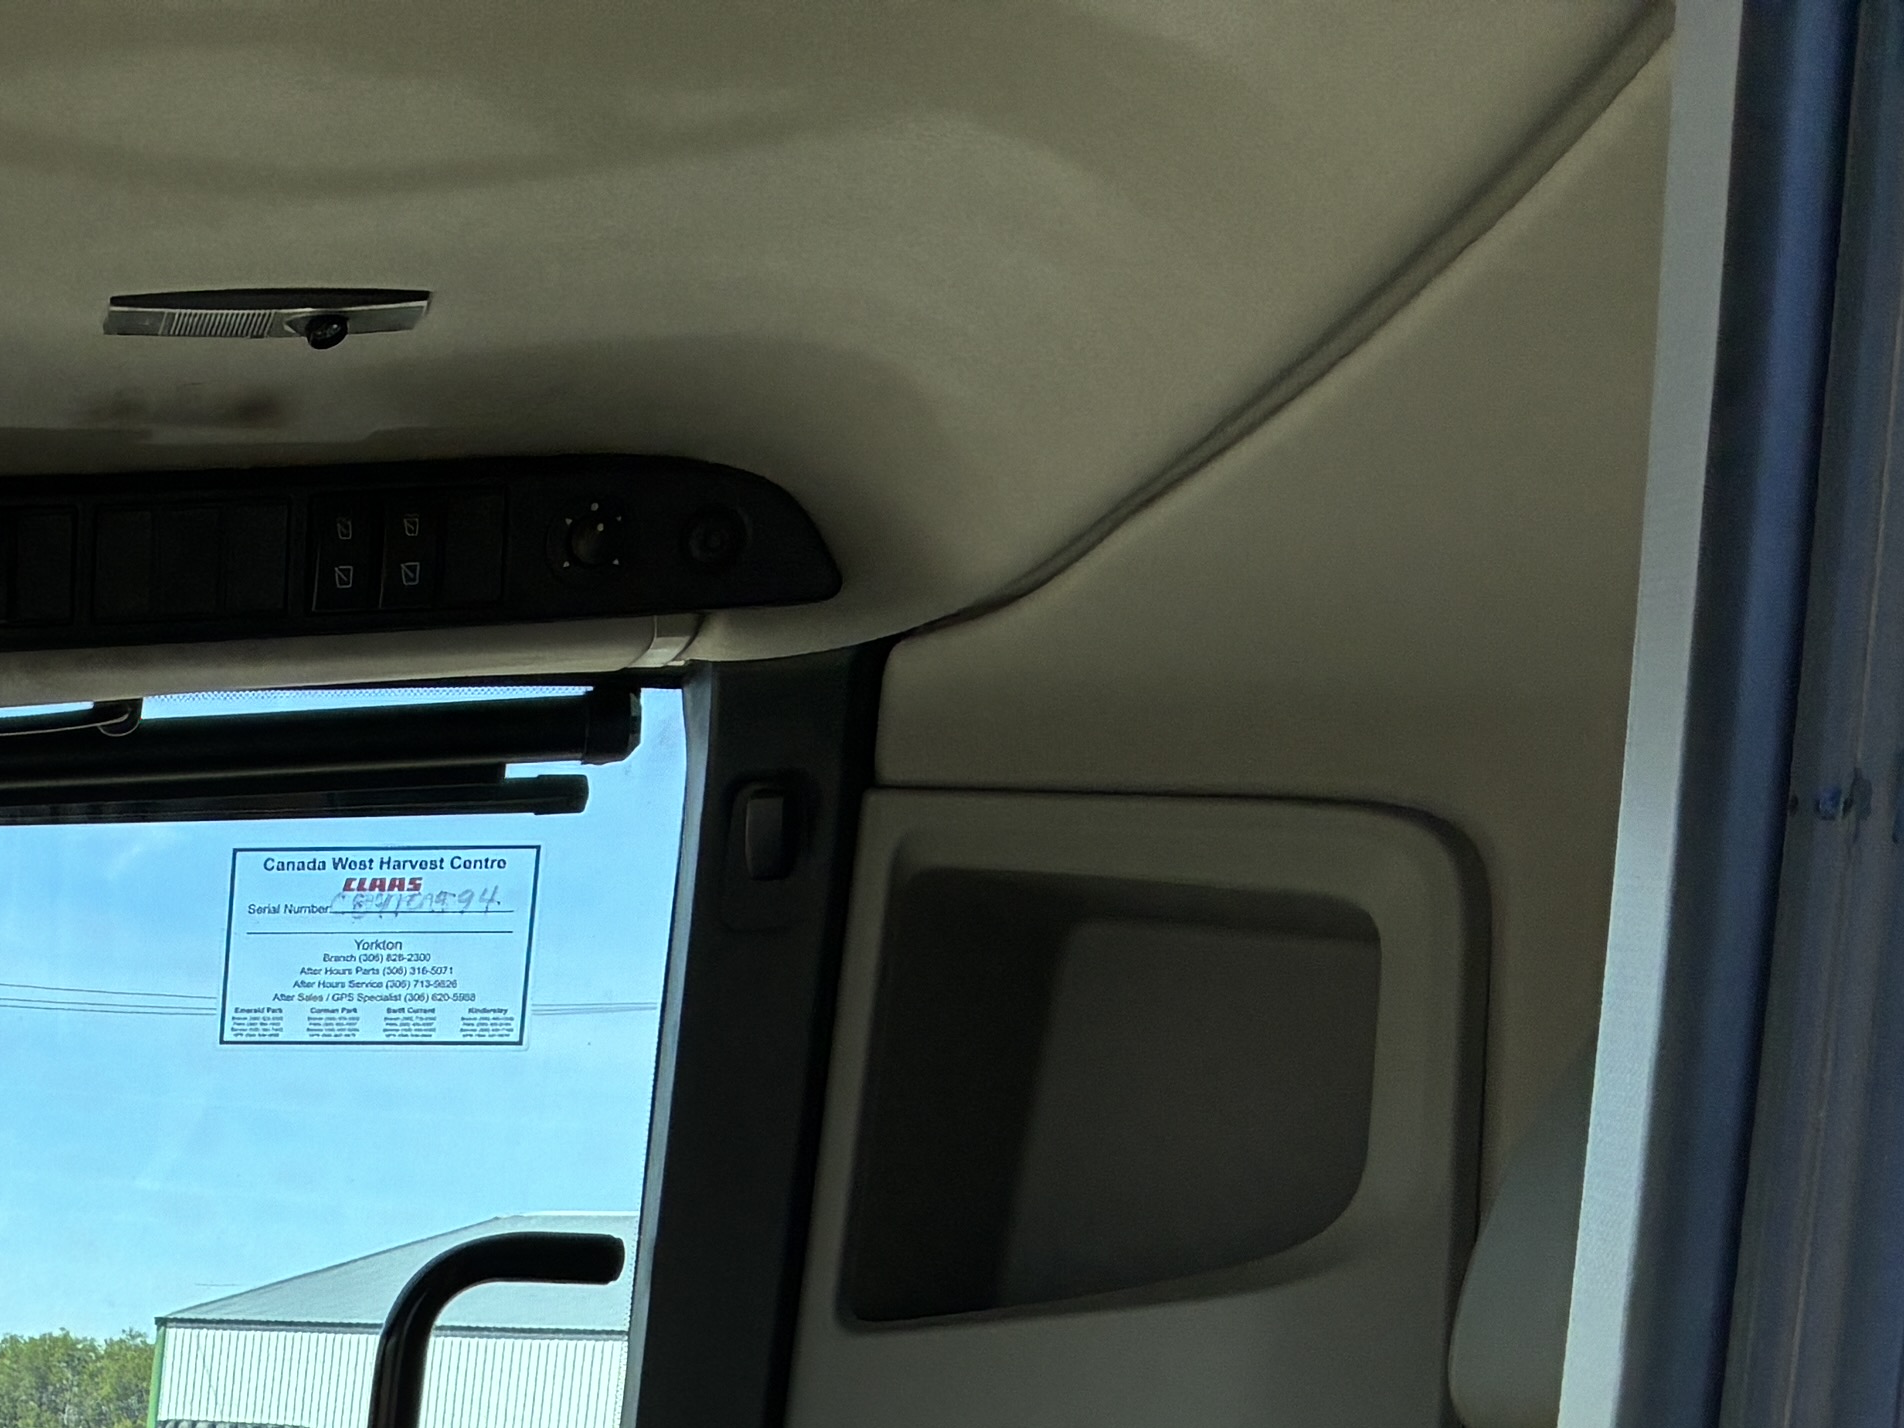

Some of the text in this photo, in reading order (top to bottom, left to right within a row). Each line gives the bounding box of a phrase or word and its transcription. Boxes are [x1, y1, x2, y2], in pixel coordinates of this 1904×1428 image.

[263, 856, 507, 872] Canada West Harvest Centre
[343, 877, 423, 892] CLAAS
[248, 904, 281, 915] Serial
[354, 939, 403, 951] Yorkton
